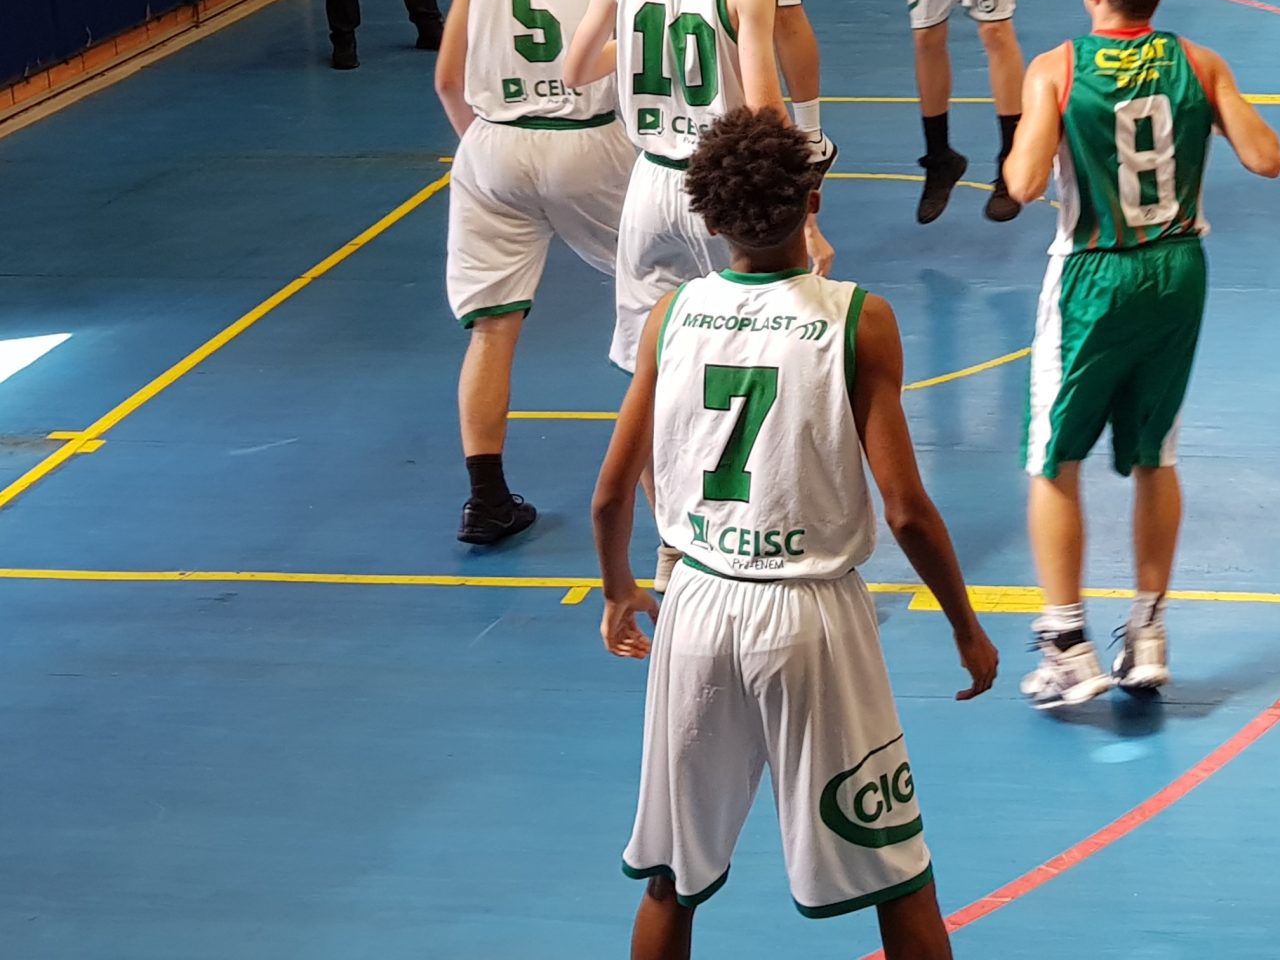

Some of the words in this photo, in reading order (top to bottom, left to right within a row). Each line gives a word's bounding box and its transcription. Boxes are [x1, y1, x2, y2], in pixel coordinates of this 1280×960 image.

[632, 1, 719, 107] 10
[1095, 37, 1169, 70] CEAT
[534, 79, 583, 98] CEIC
[1113, 93, 1181, 228] 8
[682, 312, 797, 332] MERCOPLAST
[702, 363, 780, 503] 7
[718, 526, 806, 557] CEISC
